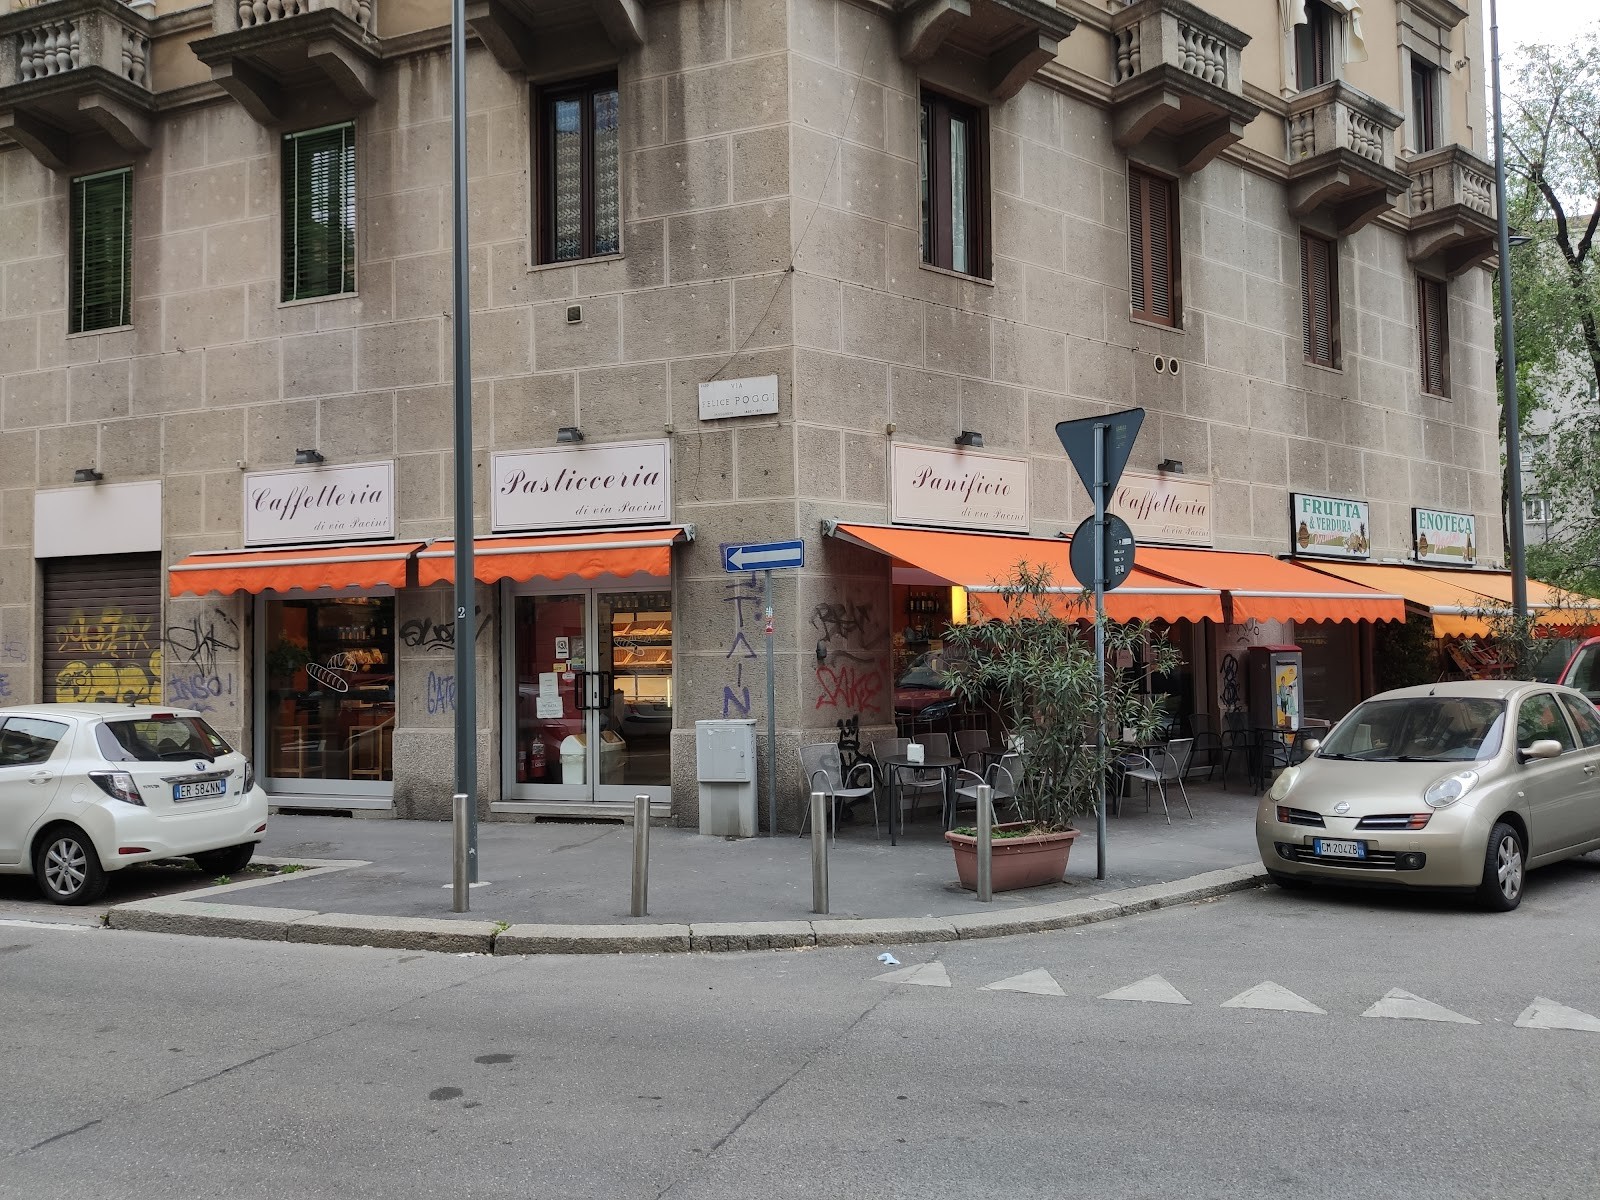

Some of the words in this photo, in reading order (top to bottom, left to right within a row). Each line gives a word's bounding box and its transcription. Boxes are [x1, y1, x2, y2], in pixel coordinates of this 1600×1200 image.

[702, 399, 730, 408] FELICE
[735, 393, 775, 405] POGGI
[500, 465, 660, 496] Pasticceria
[912, 464, 1011, 503] Panificio
[251, 484, 383, 521] Caffetteria
[575, 504, 590, 516] di
[593, 504, 612, 514] via
[618, 500, 664, 513] Pacini
[1116, 486, 1206, 520] Caffetteria
[1302, 498, 1361, 519] FRUTTA
[961, 507, 972, 517] di
[975, 511, 989, 519] via
[993, 508, 1024, 521] Pacini
[314, 521, 326, 531] di
[328, 520, 345, 530] via
[350, 516, 388, 529] Pacini
[1161, 525, 1170, 534] di
[1310, 516, 1315, 530] &
[1317, 517, 1352, 533] VERDURA
[1419, 511, 1472, 535] ENOTECA
[457, 606, 466, 619] 2
[181, 785, 192, 797] ER
[195, 779, 221, 795] 584NN
[1333, 843, 1358, 855] 204ZB
